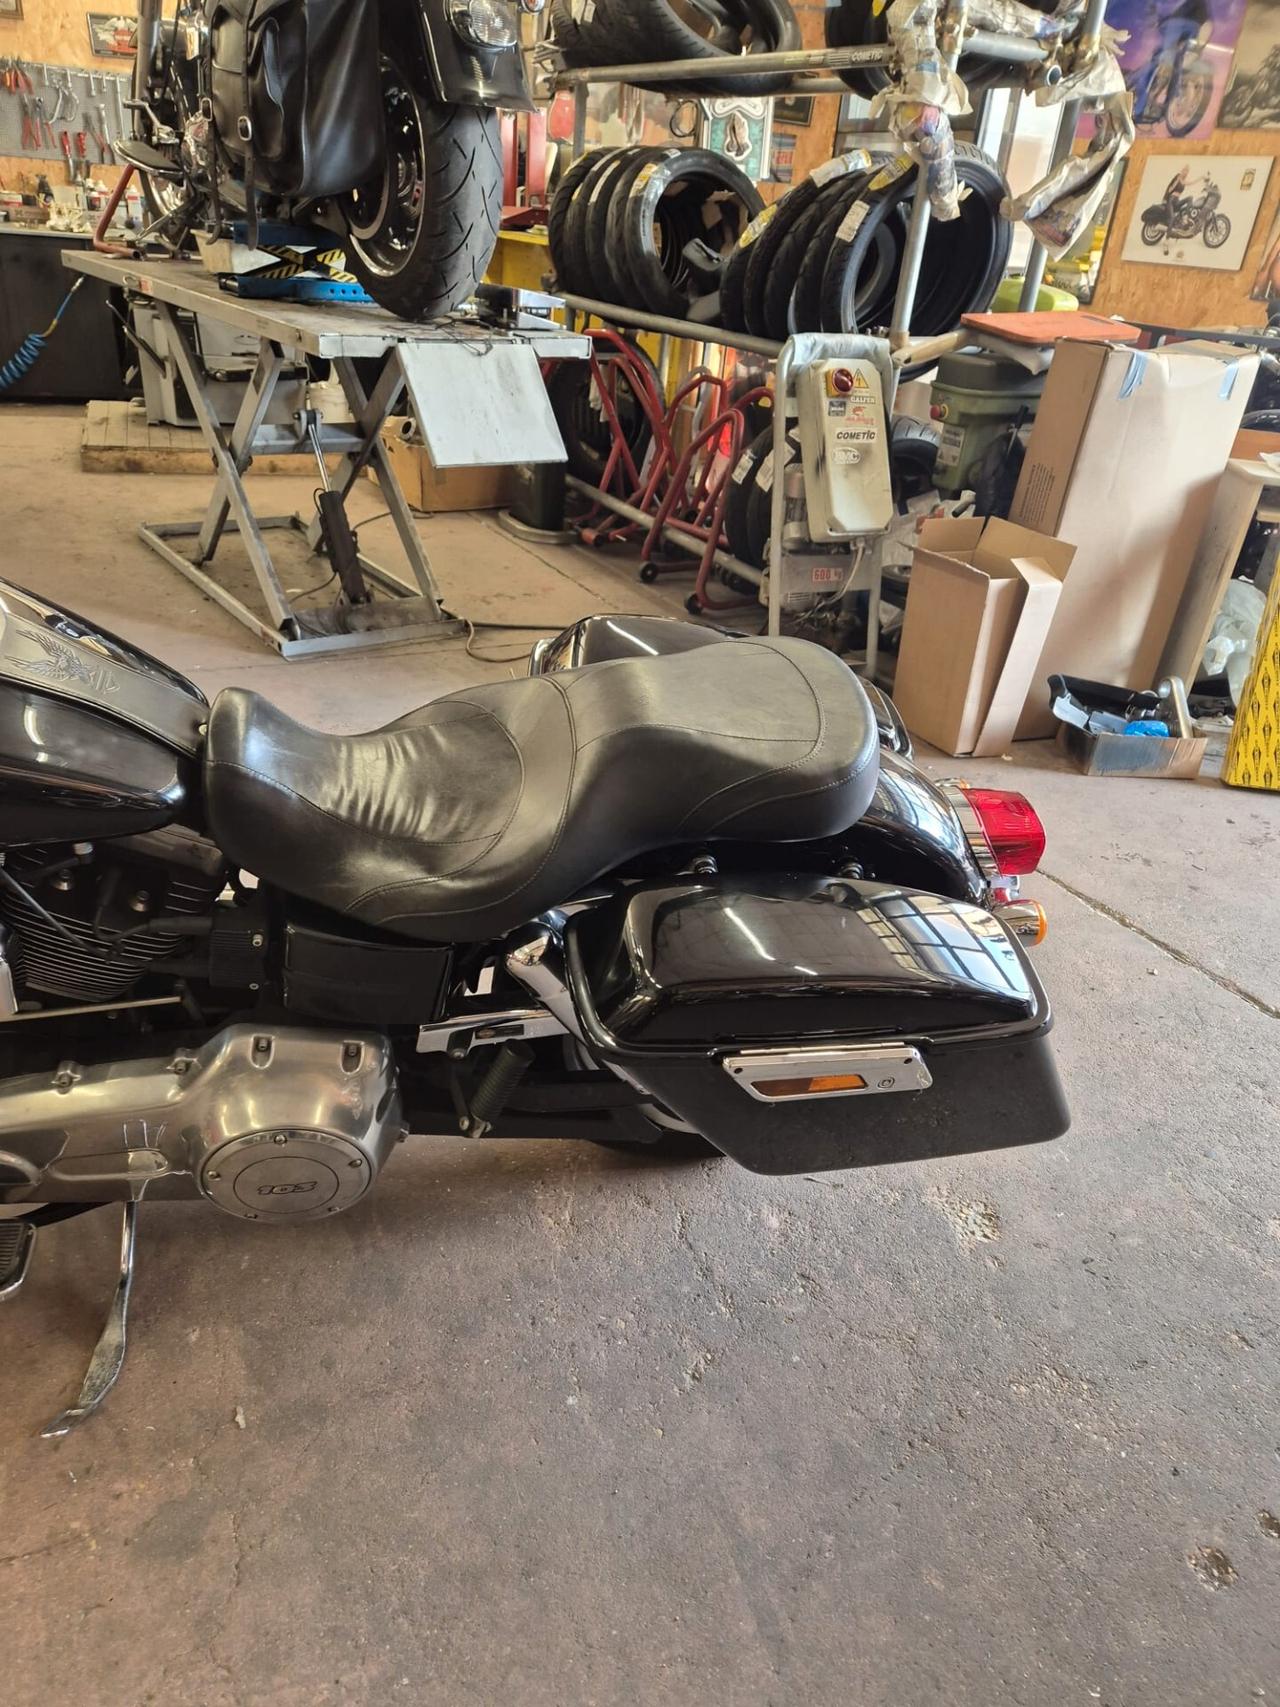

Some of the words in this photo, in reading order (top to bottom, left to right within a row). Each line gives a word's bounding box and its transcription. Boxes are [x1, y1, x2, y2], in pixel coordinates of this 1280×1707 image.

[851, 48, 884, 62] COMETIC
[836, 430, 876, 440] COMETIC
[814, 568, 831, 580] 600
